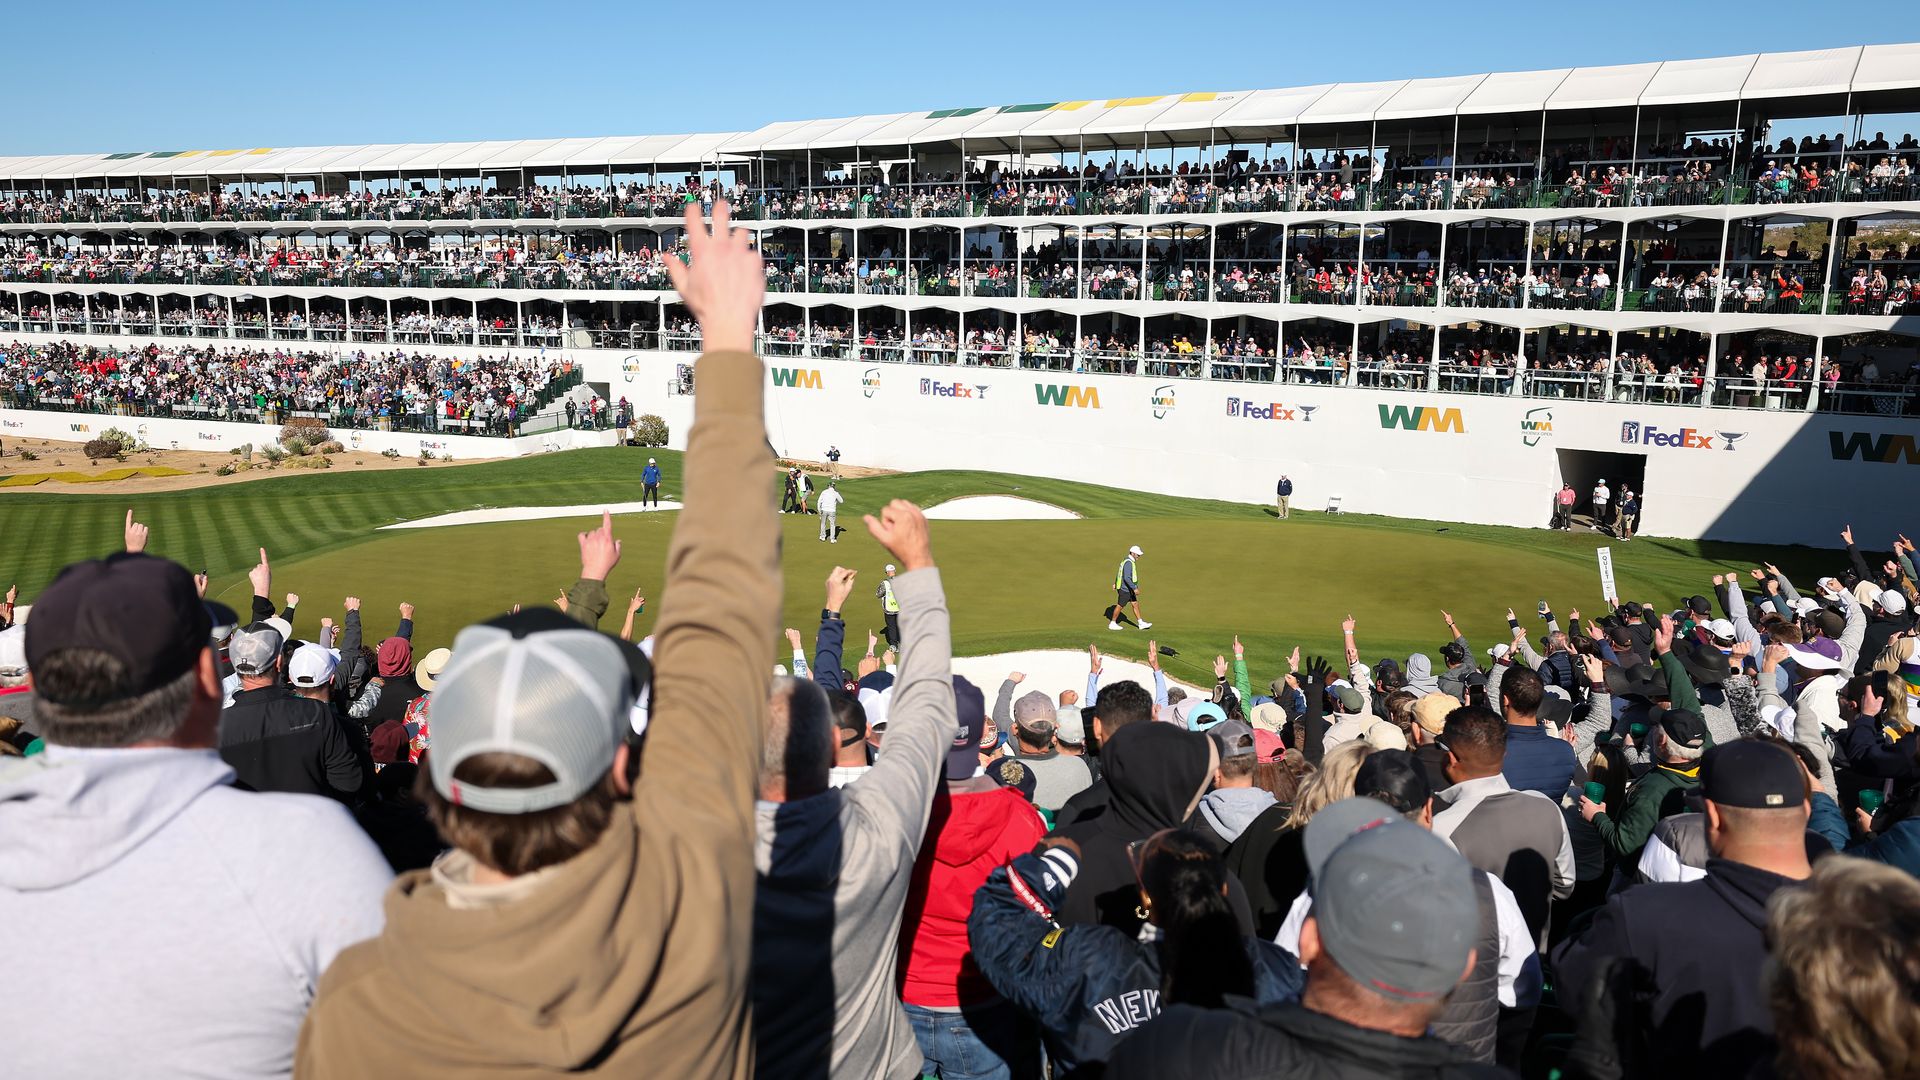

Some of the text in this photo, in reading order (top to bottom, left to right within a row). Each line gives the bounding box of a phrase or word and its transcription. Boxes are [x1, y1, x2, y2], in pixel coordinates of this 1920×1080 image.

[771, 367, 823, 389] WM
[862, 378, 880, 386] WM
[933, 381, 972, 398] FedEx
[1034, 384, 1100, 408] WM
[1151, 396, 1175, 406] WM
[1242, 401, 1295, 420] FedEx
[1378, 404, 1464, 433] WM
[70, 424, 89, 432] WM
[1521, 420, 1552, 431] WM
[1643, 426, 1713, 449] FedEx
